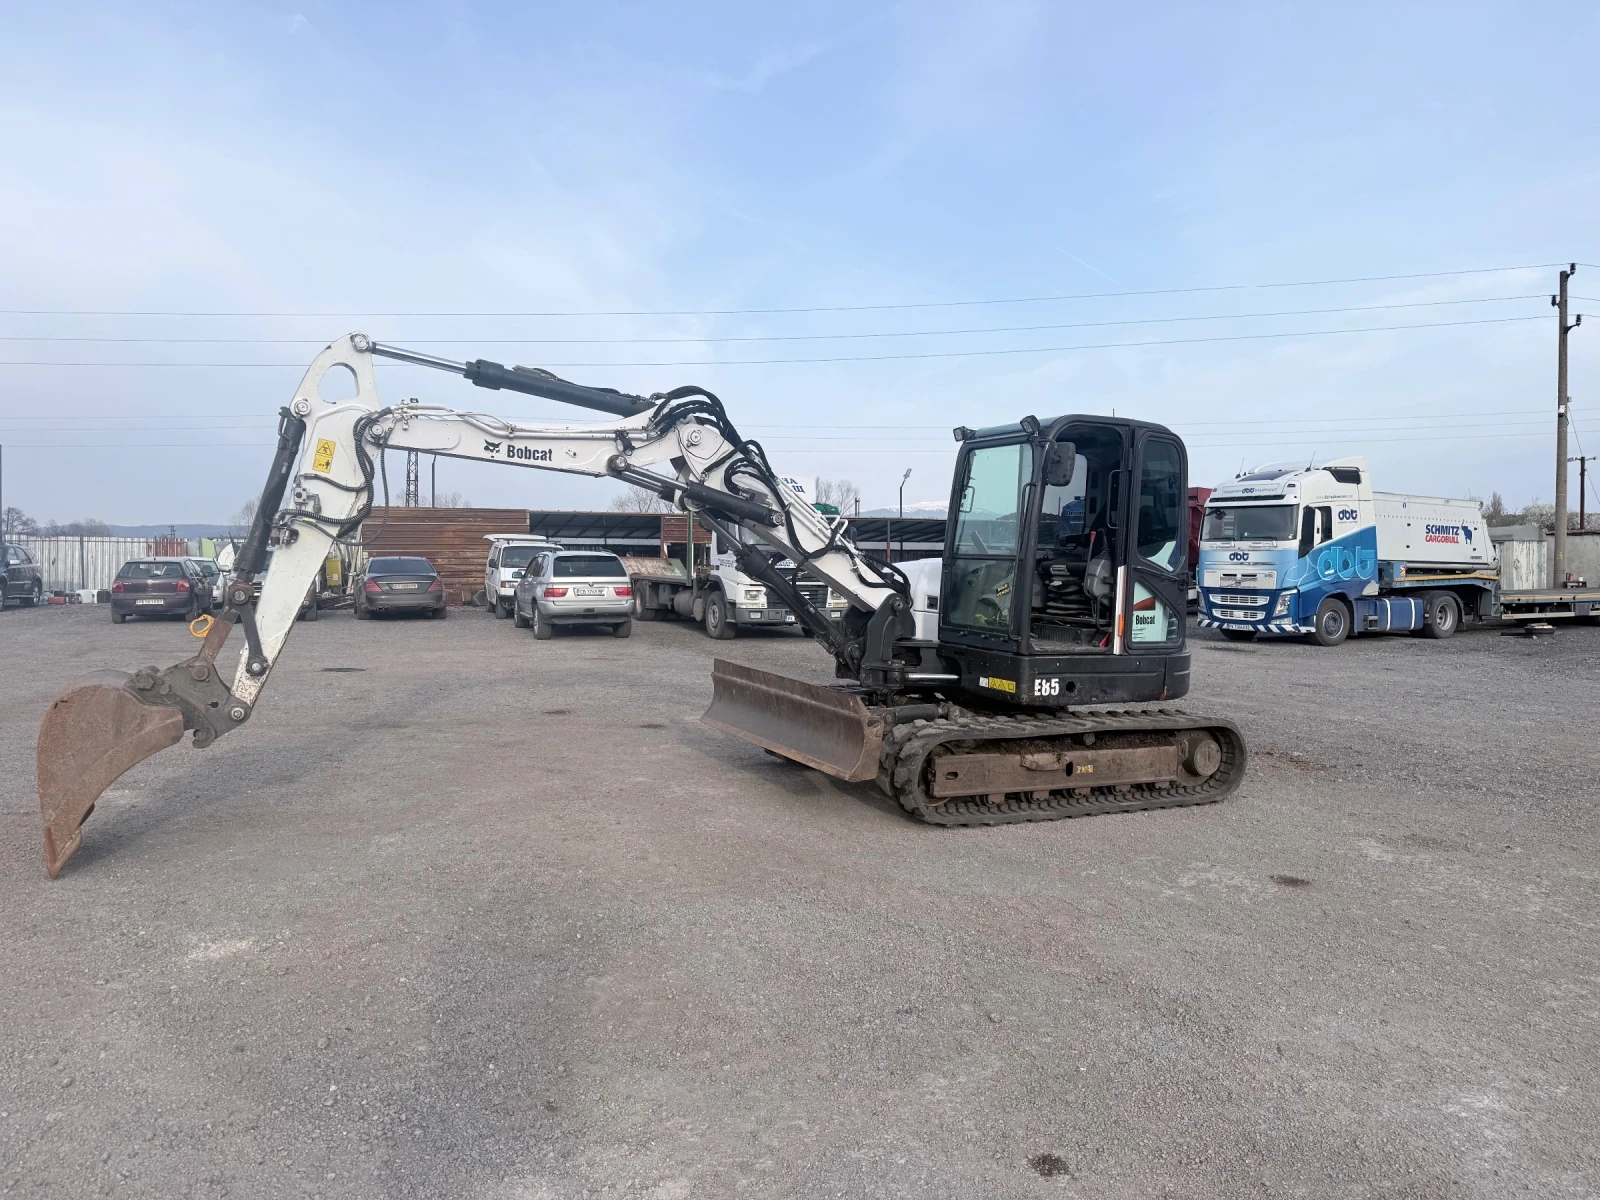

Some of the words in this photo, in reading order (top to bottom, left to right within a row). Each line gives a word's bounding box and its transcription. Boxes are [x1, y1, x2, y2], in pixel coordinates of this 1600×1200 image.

[507, 444, 553, 462] Bobcat
[1338, 509, 1358, 521] dbt
[1425, 524, 1460, 536] SCHMITZ
[1425, 534, 1460, 544] CARGOBULL
[1229, 552, 1249, 561] dbt
[1317, 546, 1375, 580] dbt
[1135, 614, 1156, 625] Bobcat
